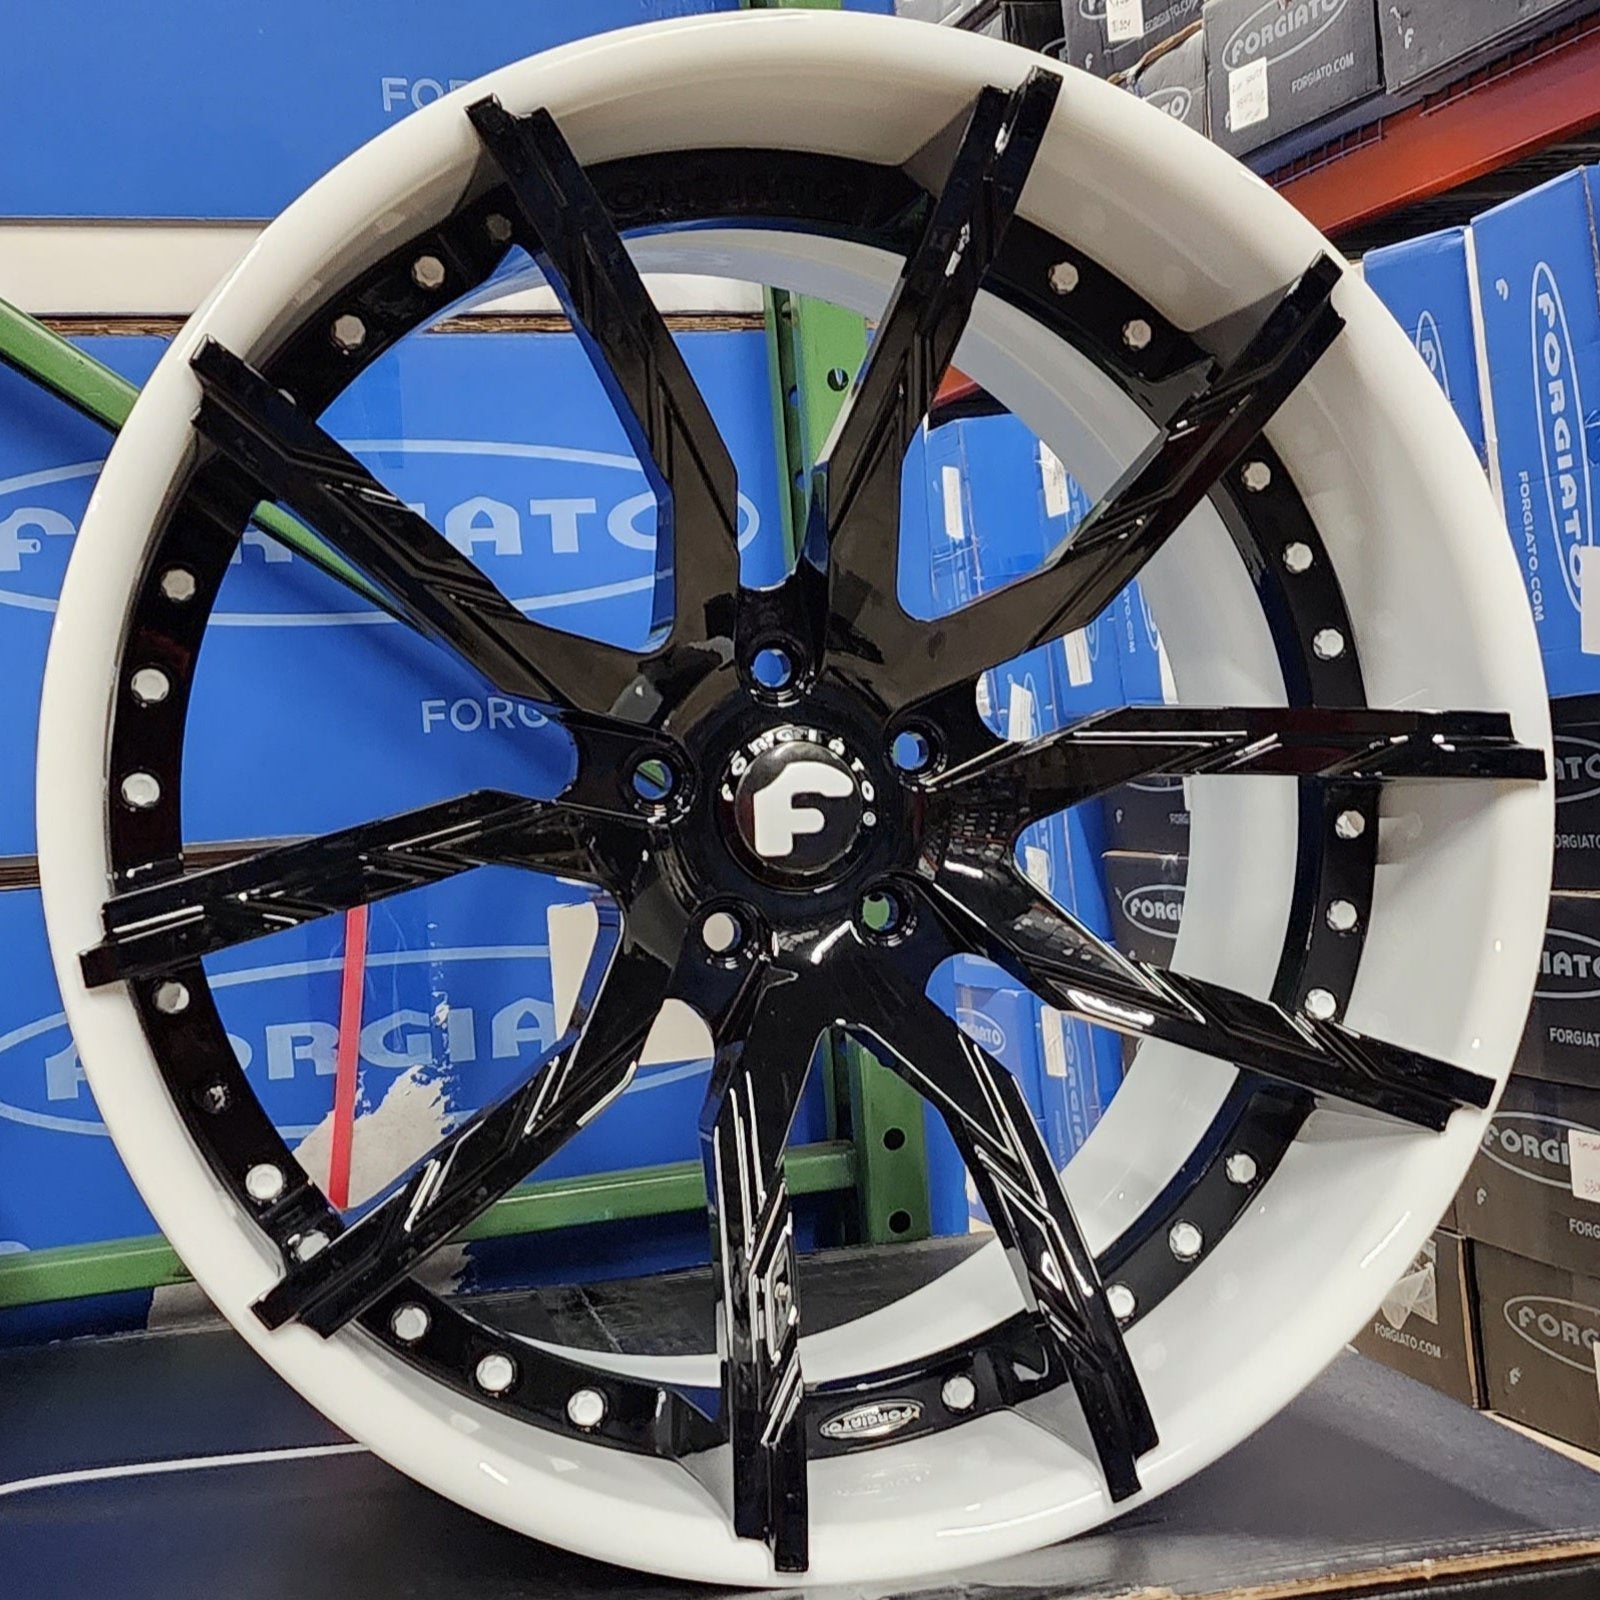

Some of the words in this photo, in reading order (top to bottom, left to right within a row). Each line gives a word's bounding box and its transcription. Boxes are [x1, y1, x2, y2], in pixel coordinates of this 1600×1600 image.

[1291, 52, 1354, 94] FORGIATO.COM
[1518, 471, 1545, 622] FORGIATO.COM
[753, 761, 854, 857] F
[1375, 1322, 1442, 1359] FORGIATO.COM
